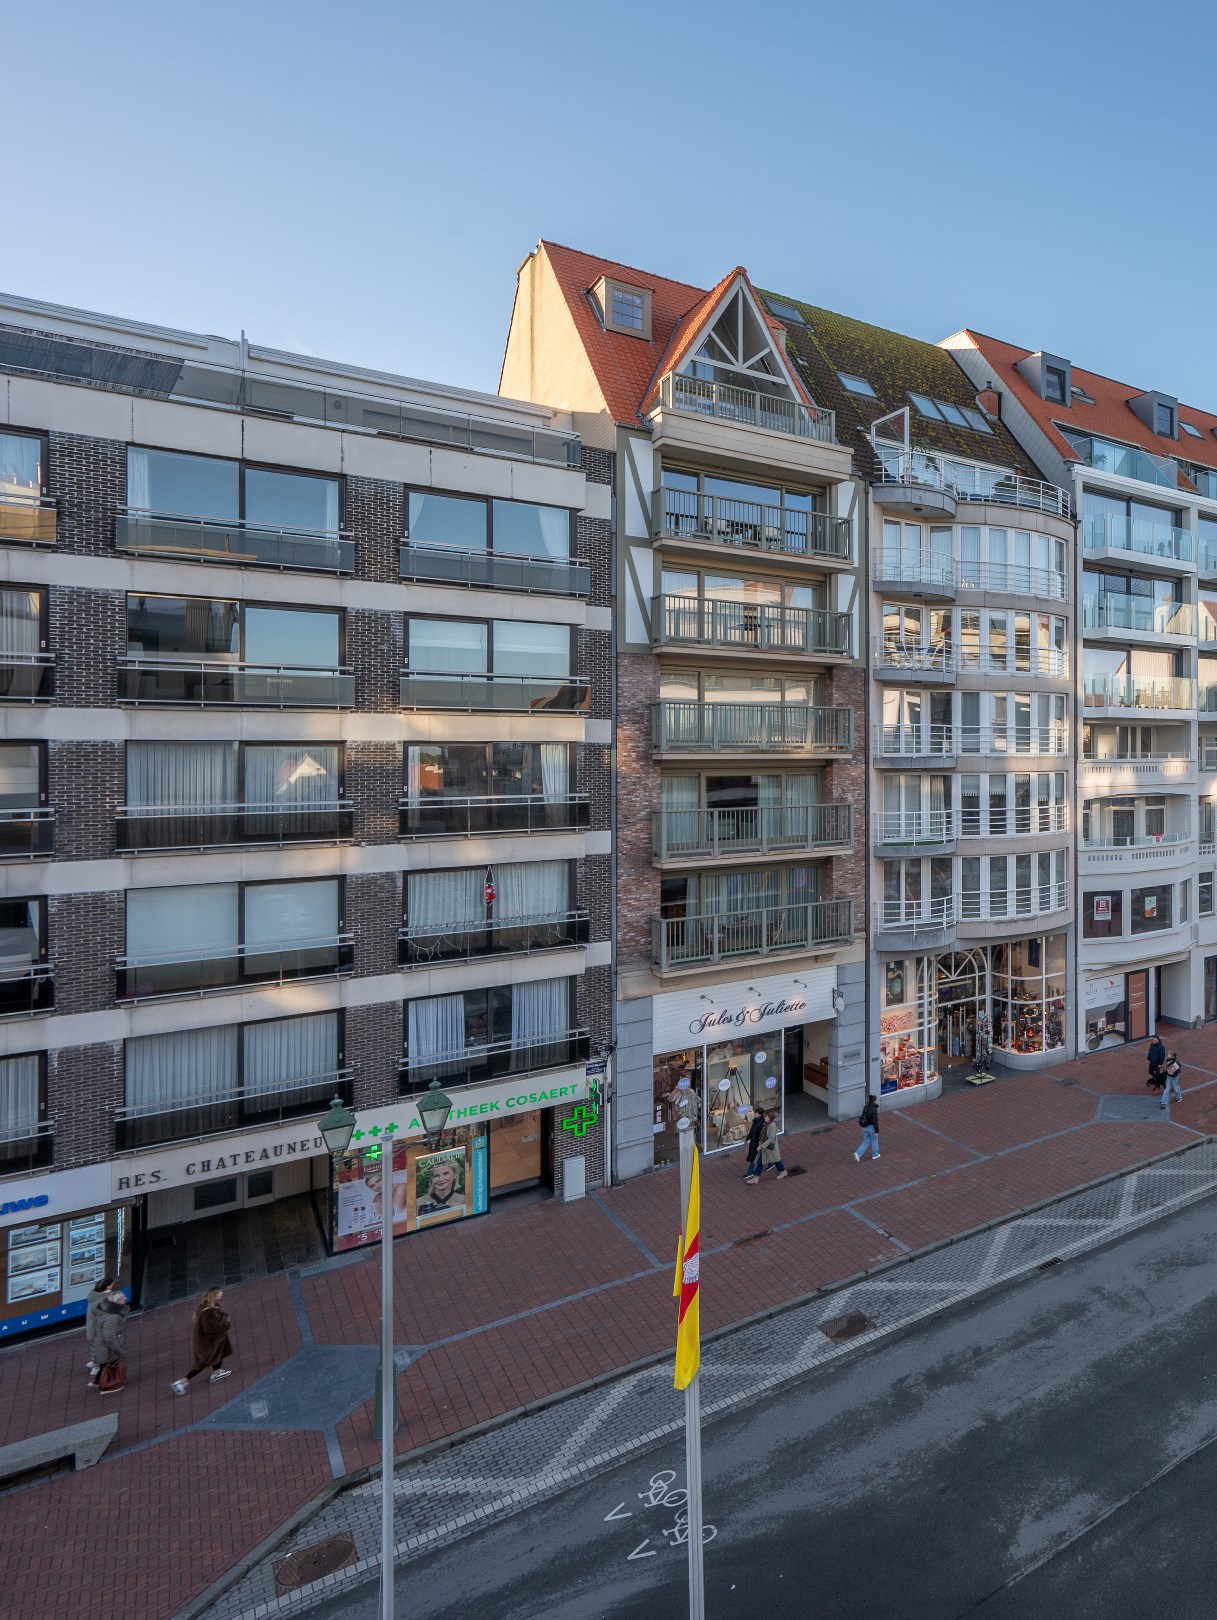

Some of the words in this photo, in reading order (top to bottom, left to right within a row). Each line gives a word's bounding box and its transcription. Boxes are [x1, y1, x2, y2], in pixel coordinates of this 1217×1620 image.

[689, 1009, 733, 1034] Jules
[733, 1006, 750, 1027] &
[750, 999, 807, 1023] Juliette
[408, 1101, 500, 1130] ATHEEK
[505, 1084, 578, 1109] COSAERT
[117, 1169, 168, 1191] RES.
[185, 1136, 324, 1176] CHATEAUNEU
